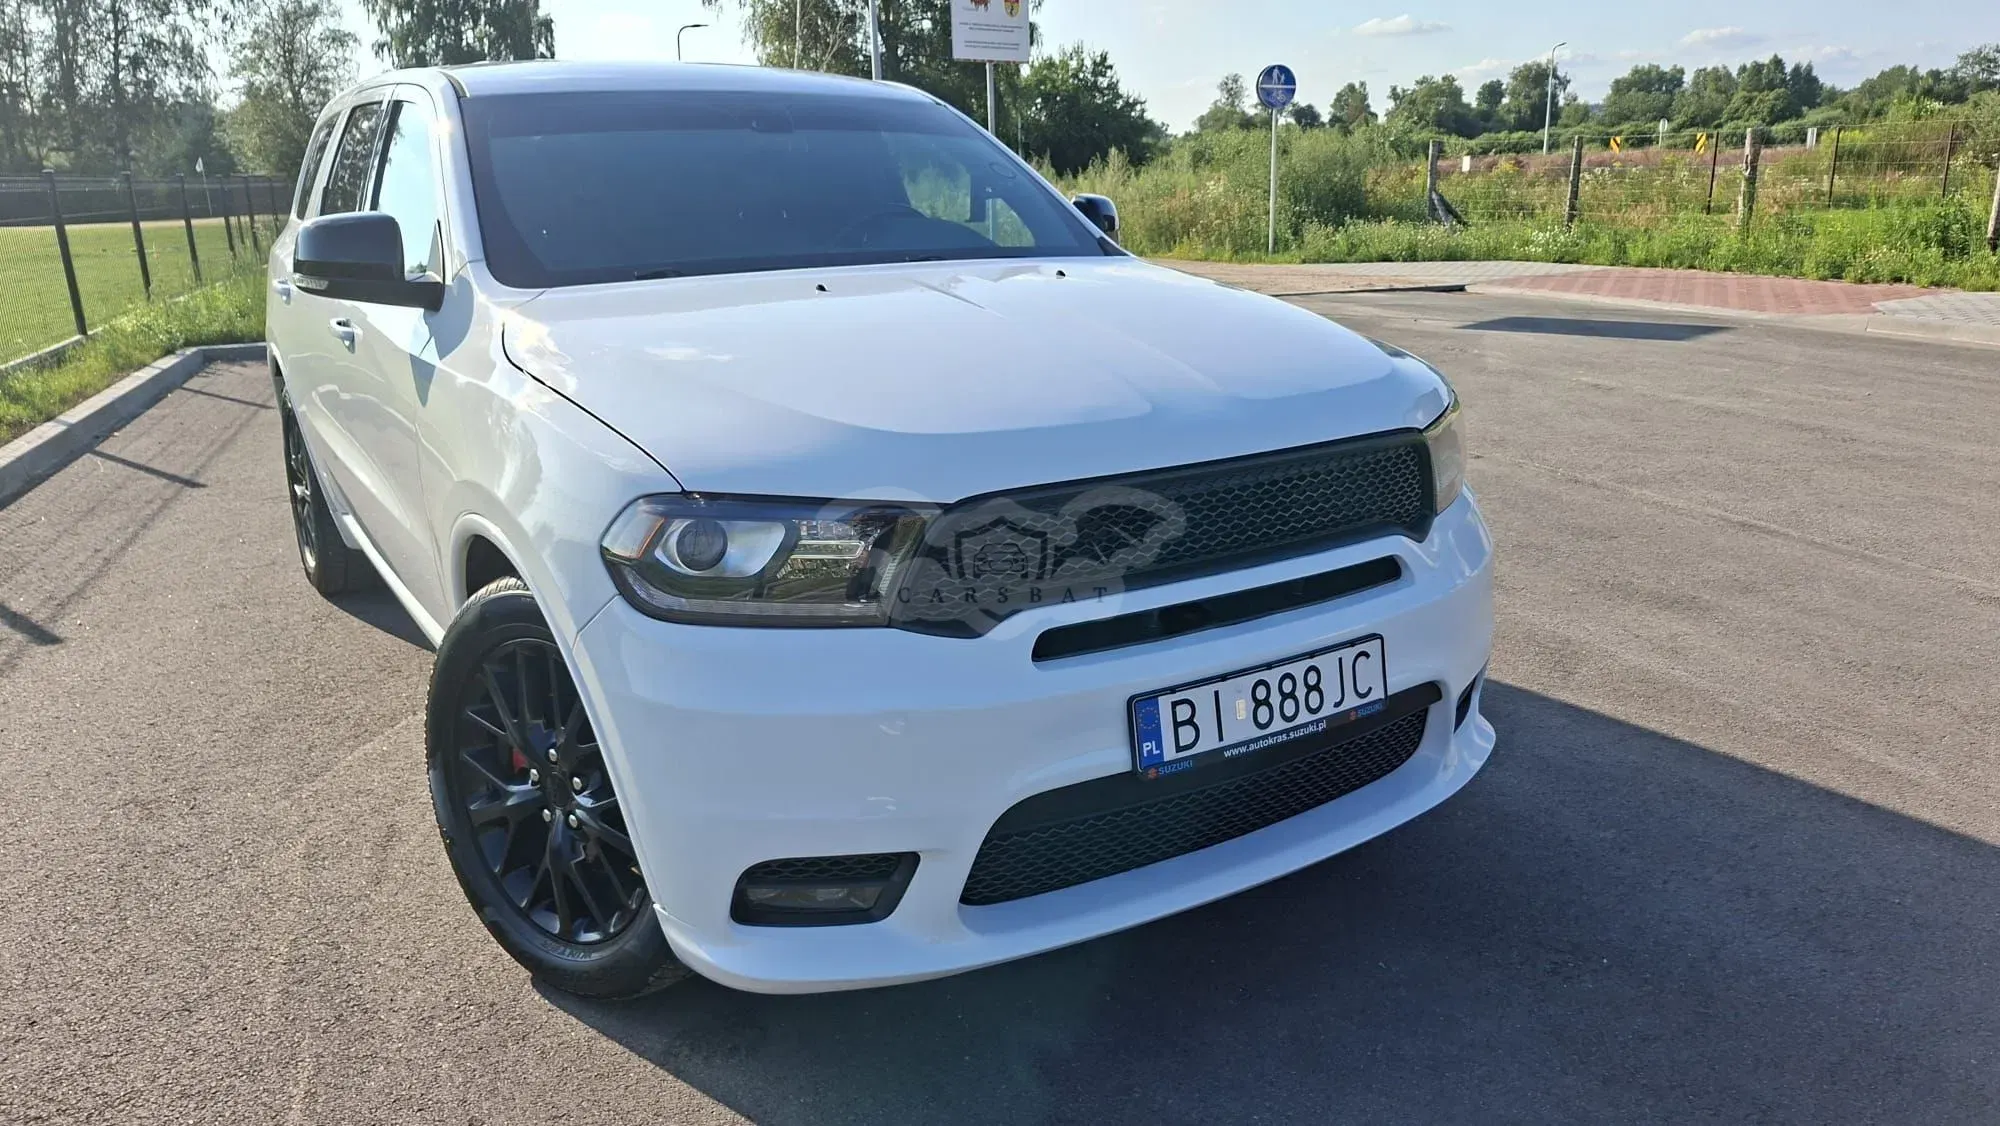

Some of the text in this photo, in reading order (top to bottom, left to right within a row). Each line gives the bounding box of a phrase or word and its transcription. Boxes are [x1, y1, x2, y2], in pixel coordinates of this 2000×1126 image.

[1171, 650, 1374, 754] BI 888JC
[1357, 702, 1383, 717] SUZUKI
[1223, 720, 1327, 758] www.autokras.suzuki.pl
[1142, 741, 1160, 757] PL
[1158, 760, 1193, 775] SUZUKI
